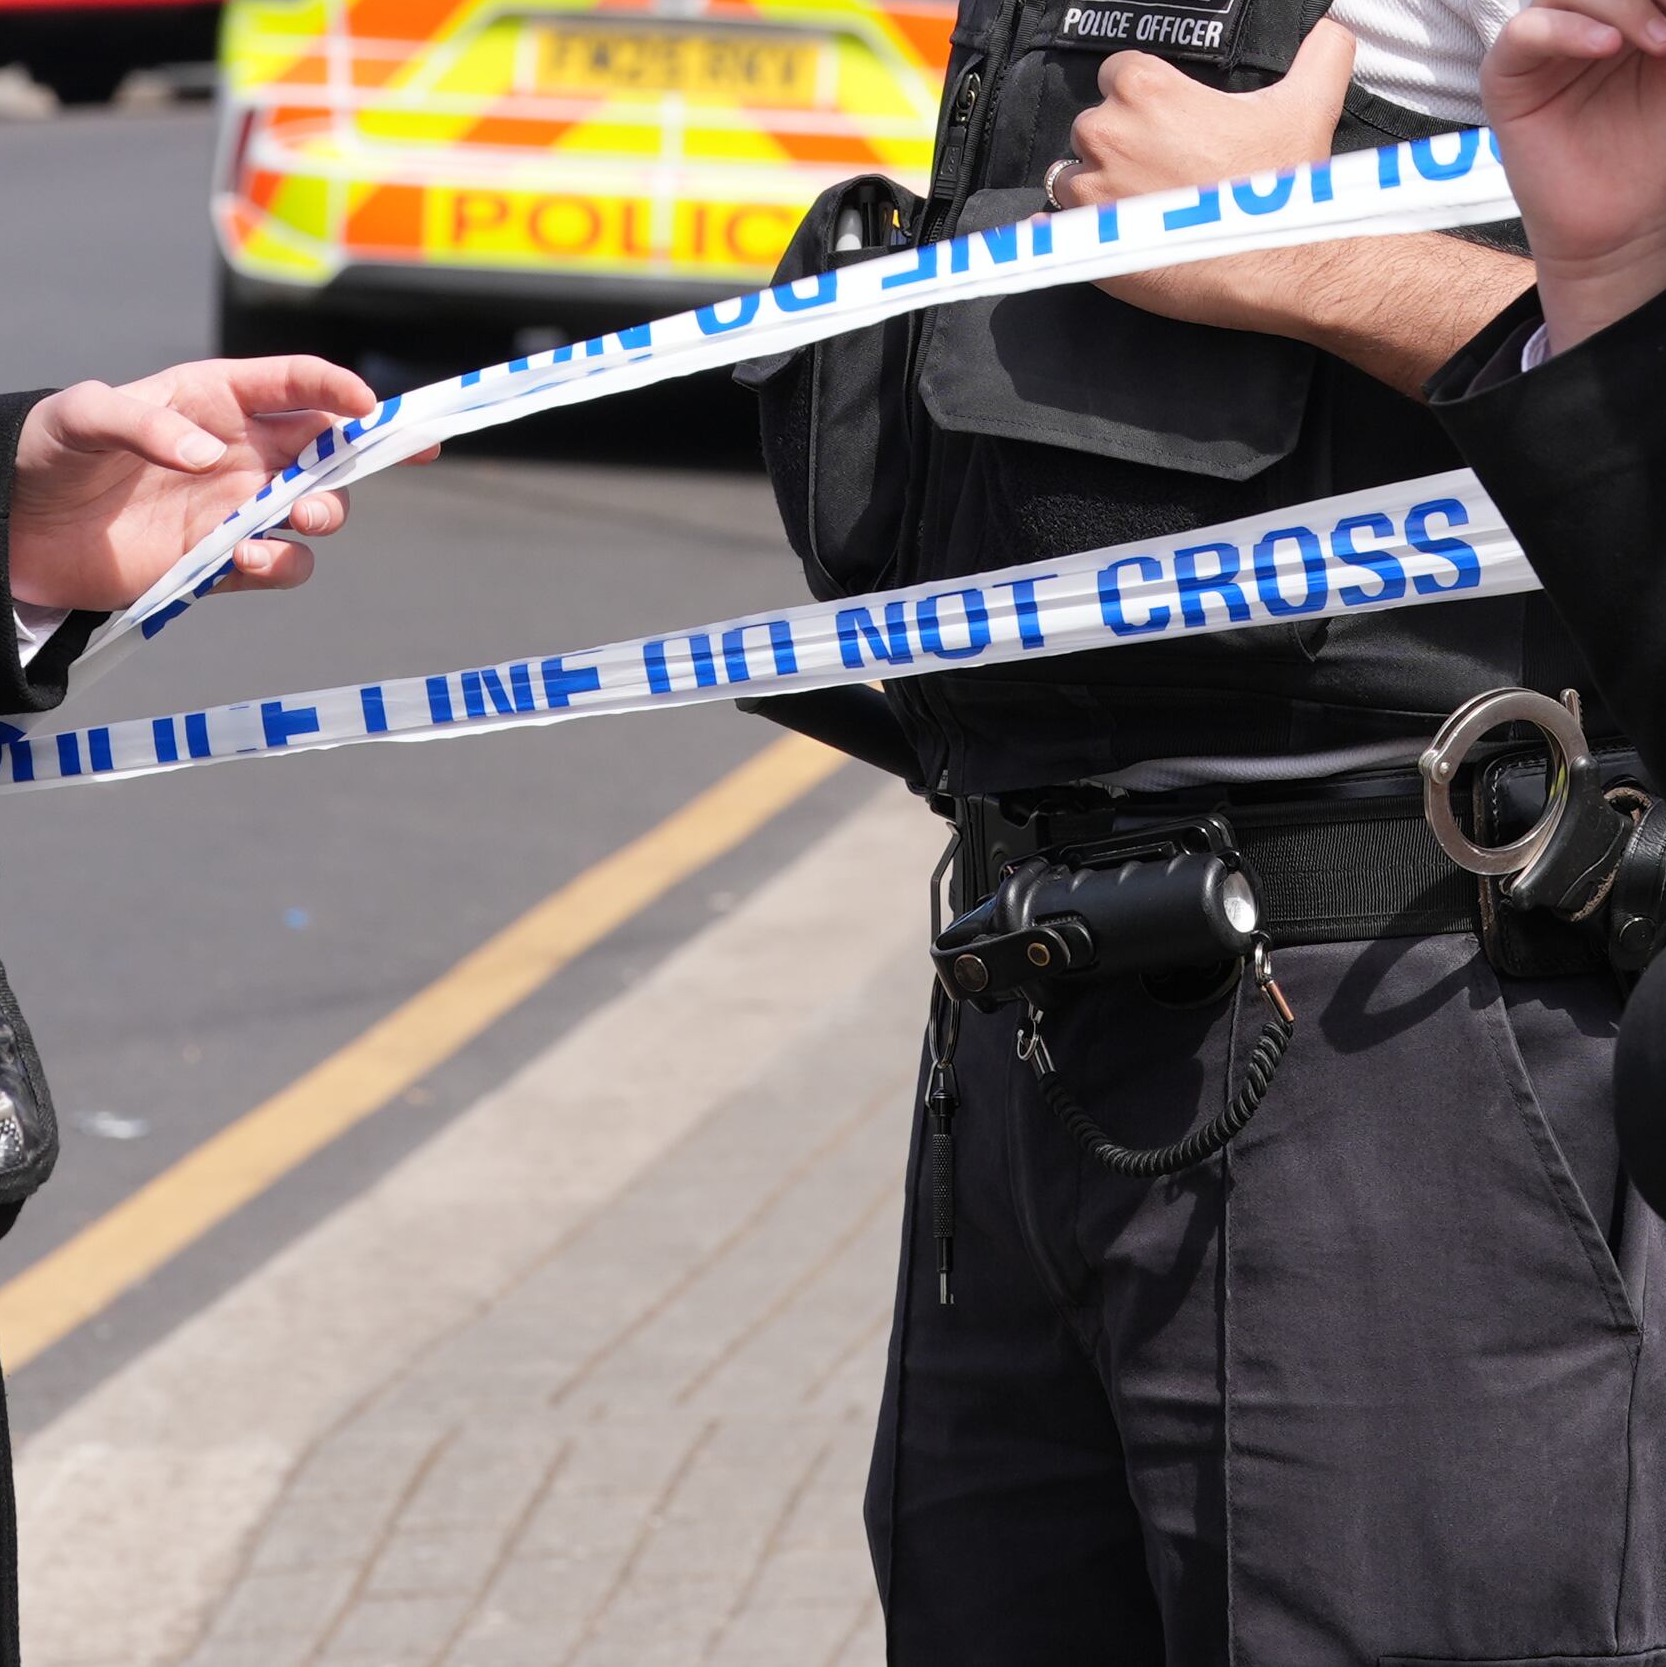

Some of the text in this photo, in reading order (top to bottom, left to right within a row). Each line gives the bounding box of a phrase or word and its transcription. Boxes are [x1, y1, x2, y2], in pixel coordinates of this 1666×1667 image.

[1064, 7, 1223, 48] POLICE OFFICER
[451, 191, 793, 265] POLIC
[836, 573, 1059, 669] NOT
[1098, 497, 1482, 638] CROSS
